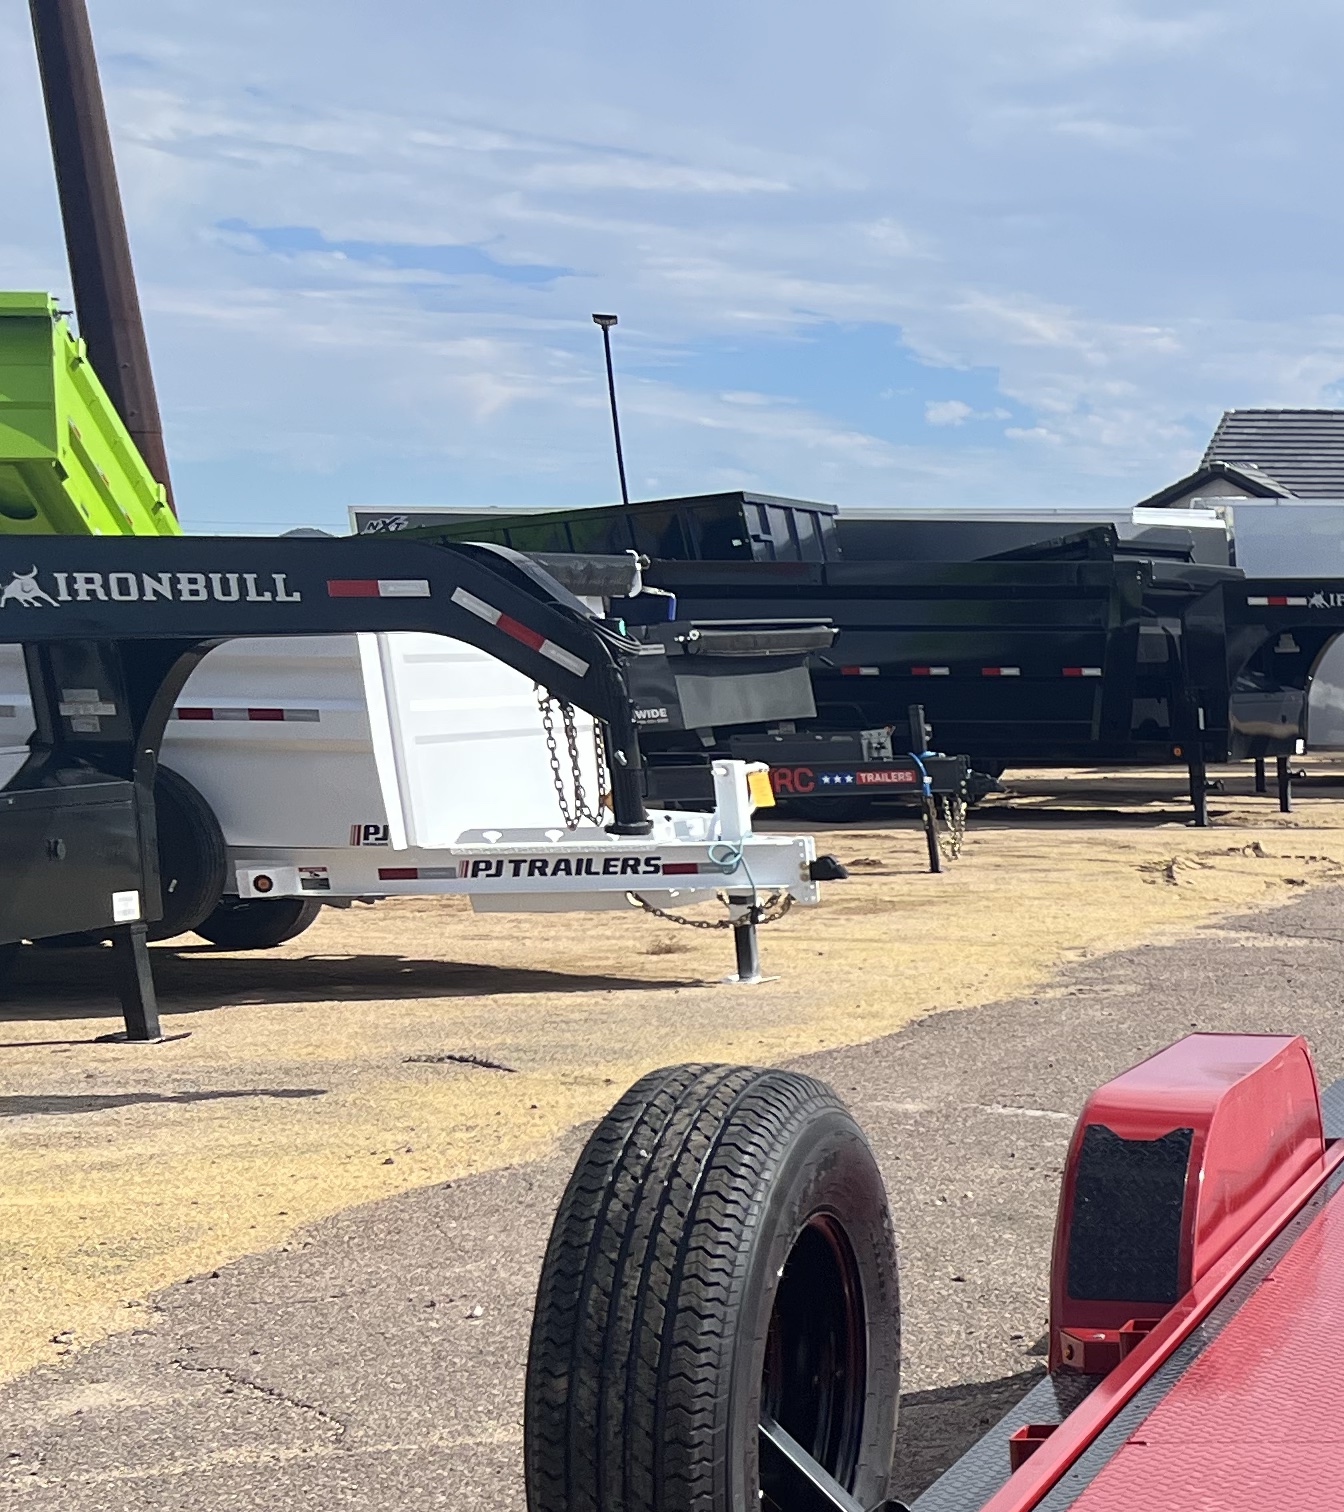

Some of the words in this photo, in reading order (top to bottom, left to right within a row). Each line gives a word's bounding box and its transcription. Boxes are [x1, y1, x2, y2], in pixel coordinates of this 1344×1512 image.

[53, 572, 300, 602] IRONBULL
[769, 767, 815, 794] RC
[860, 771, 913, 783] TRAILERS
[363, 824, 389, 841] PJ
[471, 859, 504, 878] PJ
[508, 856, 661, 877] TRAILERS
